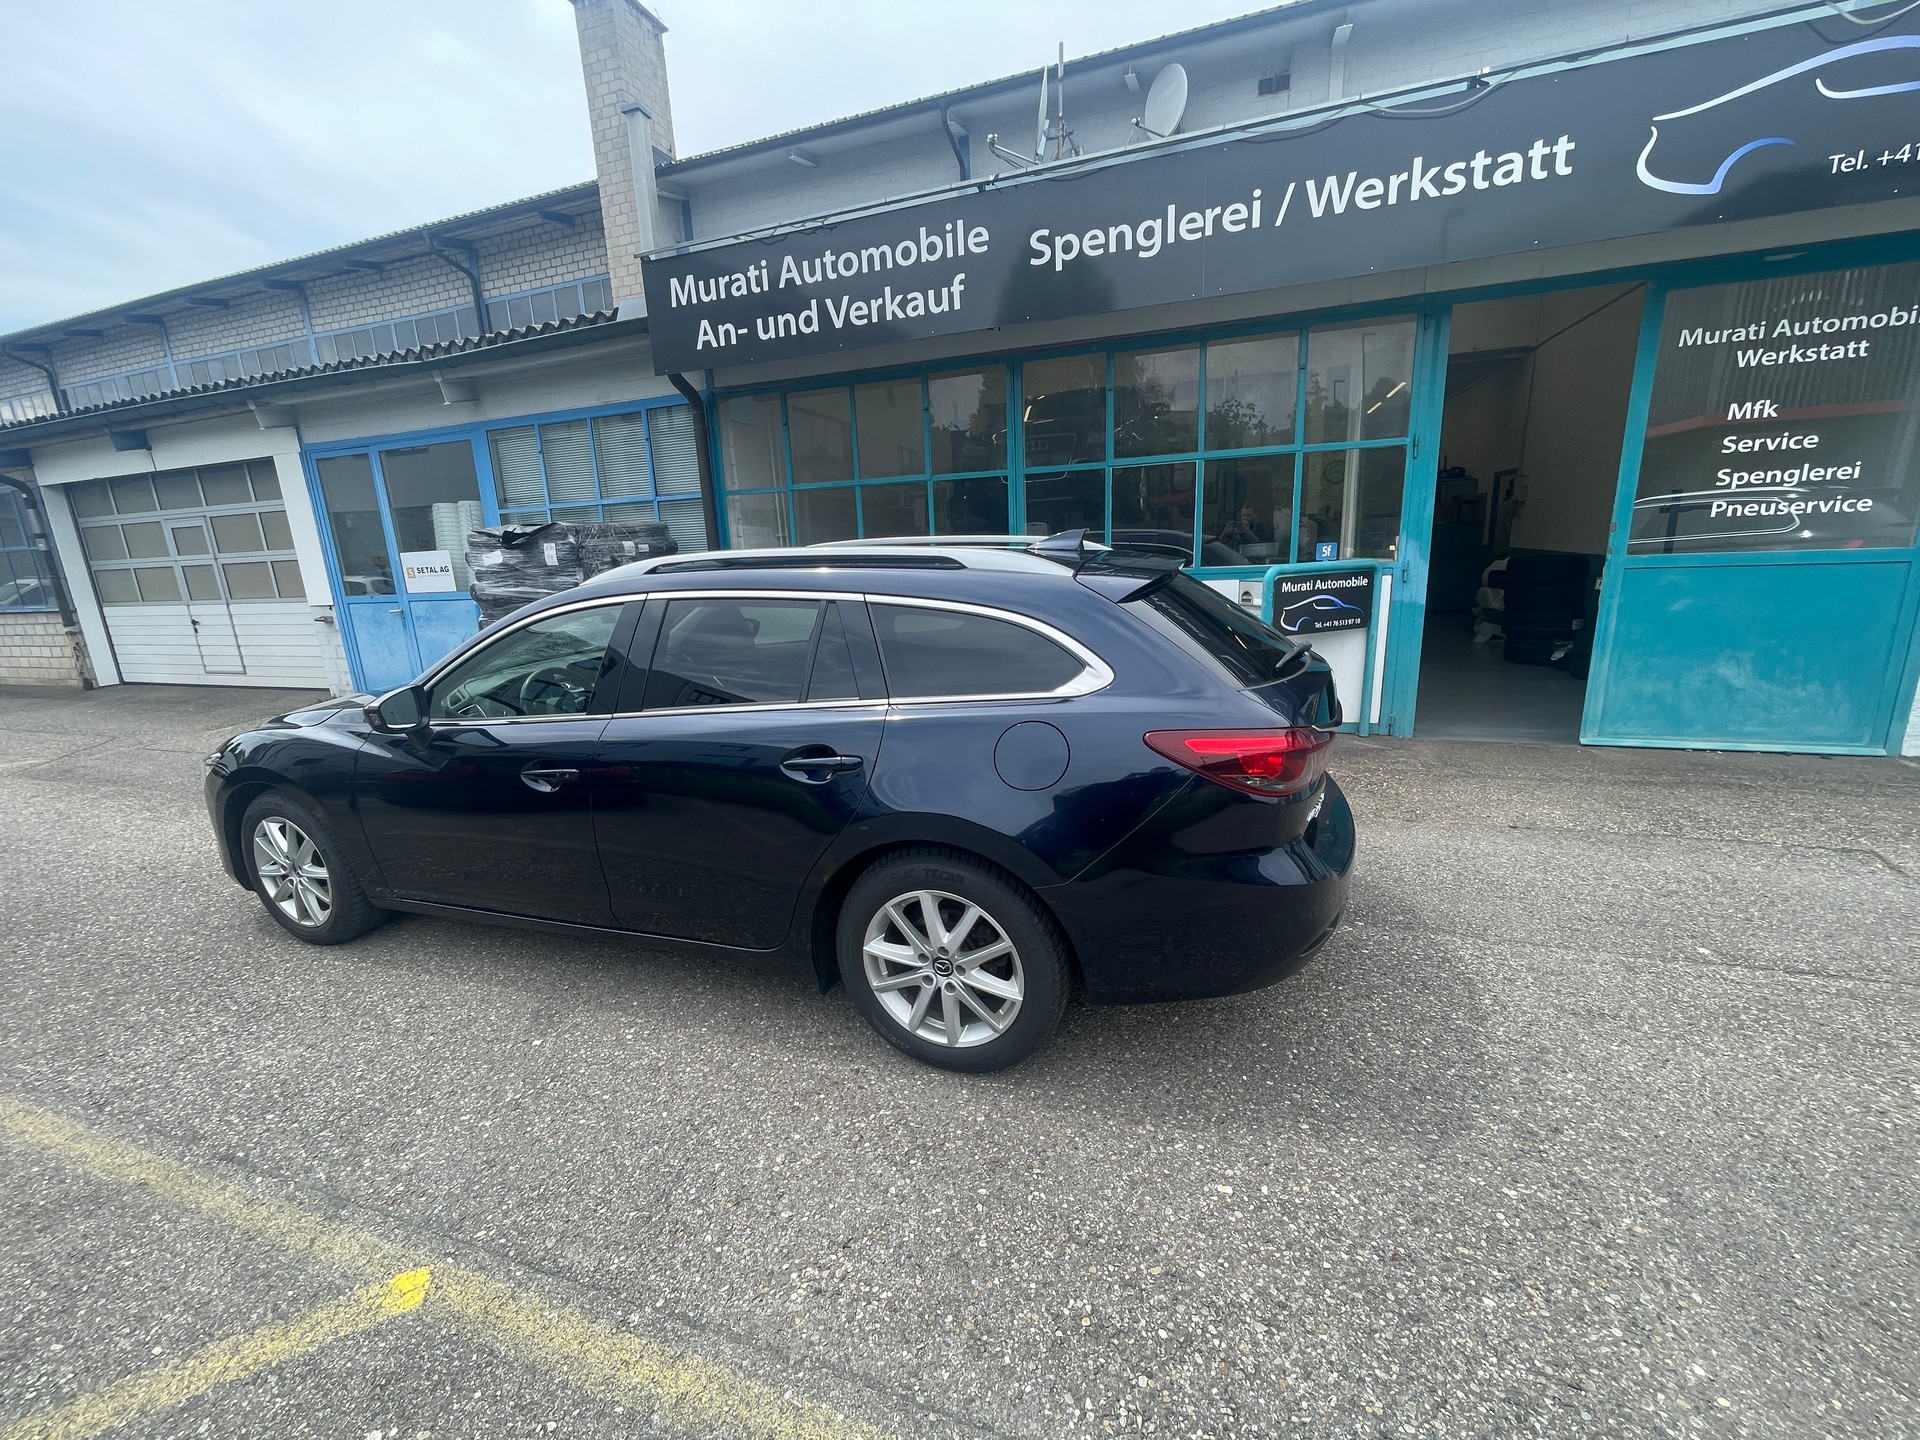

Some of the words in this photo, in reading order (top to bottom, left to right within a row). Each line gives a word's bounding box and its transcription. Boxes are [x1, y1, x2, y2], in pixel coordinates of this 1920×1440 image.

[1828, 150, 1869, 174] Tel.
[1030, 188, 1262, 272] Spenglerei
[1274, 182, 1296, 227] /
[1305, 134, 1576, 218] Werkstatt
[669, 259, 769, 308] Murati
[778, 219, 990, 289] Automobile
[696, 319, 748, 351] An-
[756, 300, 819, 341] und
[825, 273, 966, 329] Verkauf
[1678, 320, 1767, 348] Murati
[1736, 339, 1871, 368] Werkstatt
[1726, 399, 1780, 421] Mfk
[1720, 431, 1820, 454] Service
[1715, 461, 1862, 490] Spenglerei
[1710, 495, 1873, 518] Pneuservice
[1321, 544, 1333, 558] 5f
[416, 566, 438, 575] SETAL
[439, 565, 450, 573] AG
[1281, 580, 1313, 593] Murati
[1315, 575, 1369, 590] Automobile
